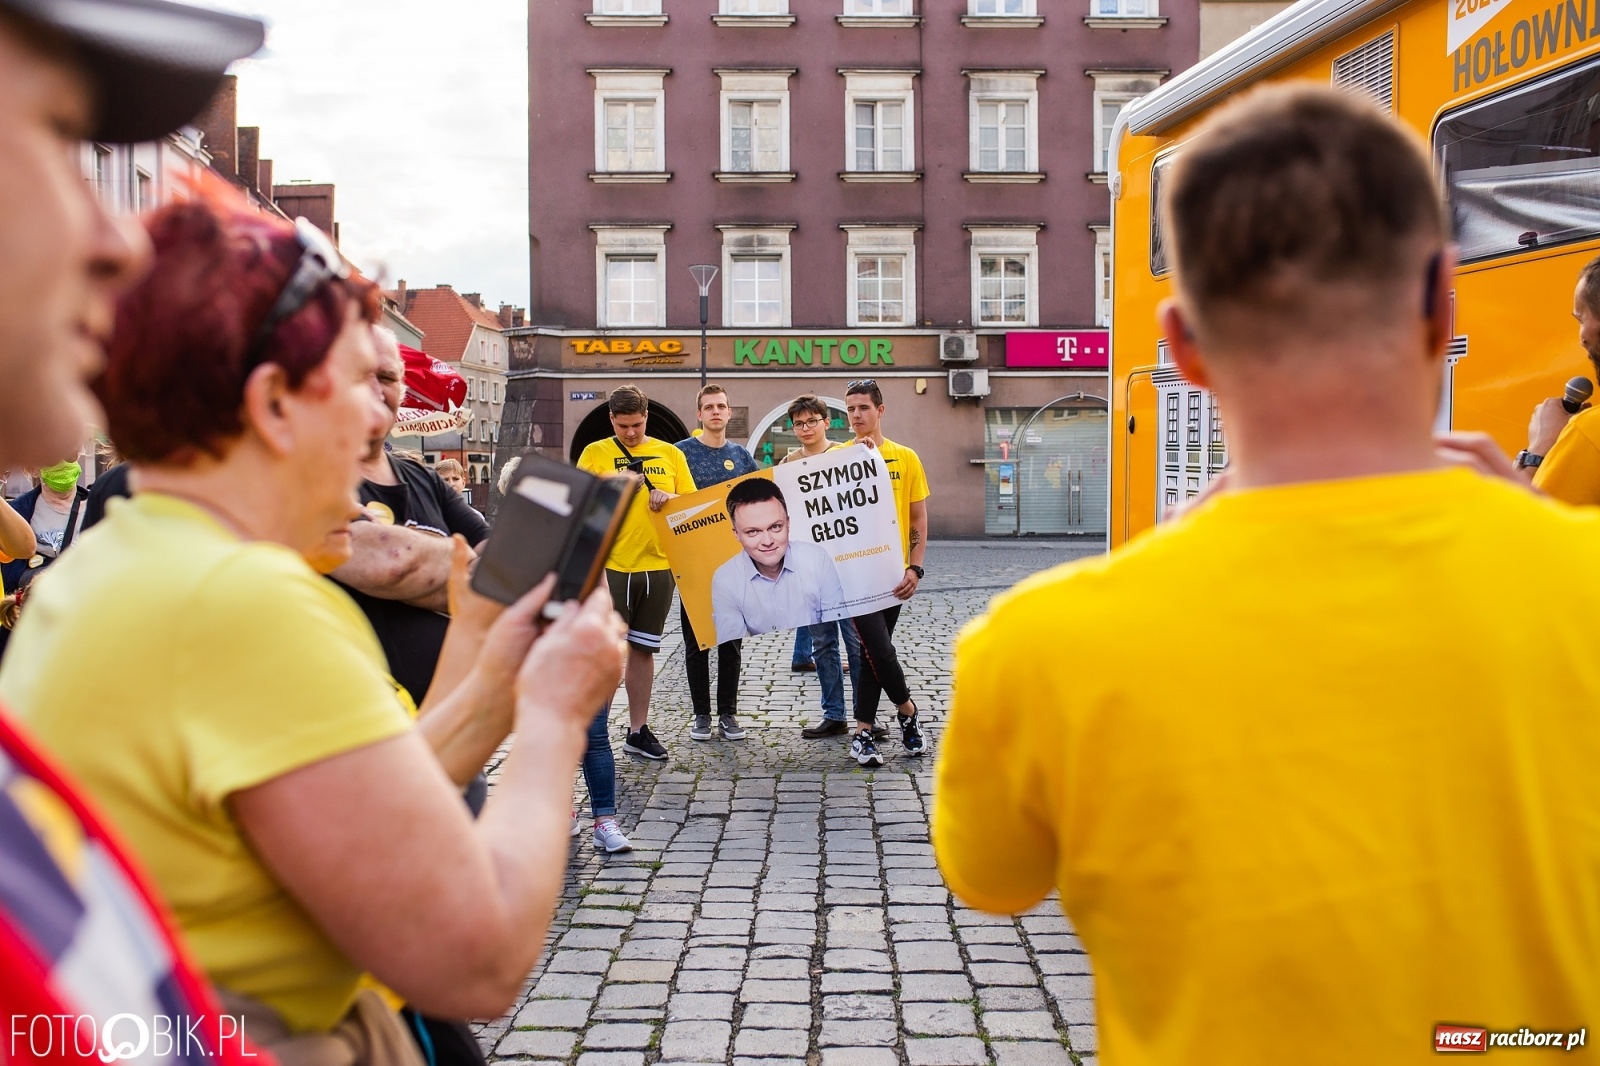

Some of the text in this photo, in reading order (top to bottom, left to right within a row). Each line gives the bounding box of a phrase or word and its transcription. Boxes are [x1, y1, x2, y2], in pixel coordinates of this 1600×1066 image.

[571, 339, 683, 355] TABAC
[734, 338, 894, 365] KANTOR
[797, 458, 878, 494] SZYMON
[804, 481, 879, 518] MA MÓJ
[669, 512, 687, 523] 2020
[672, 512, 727, 536] HOŁOWNIA
[811, 515, 859, 543] GŁOS
